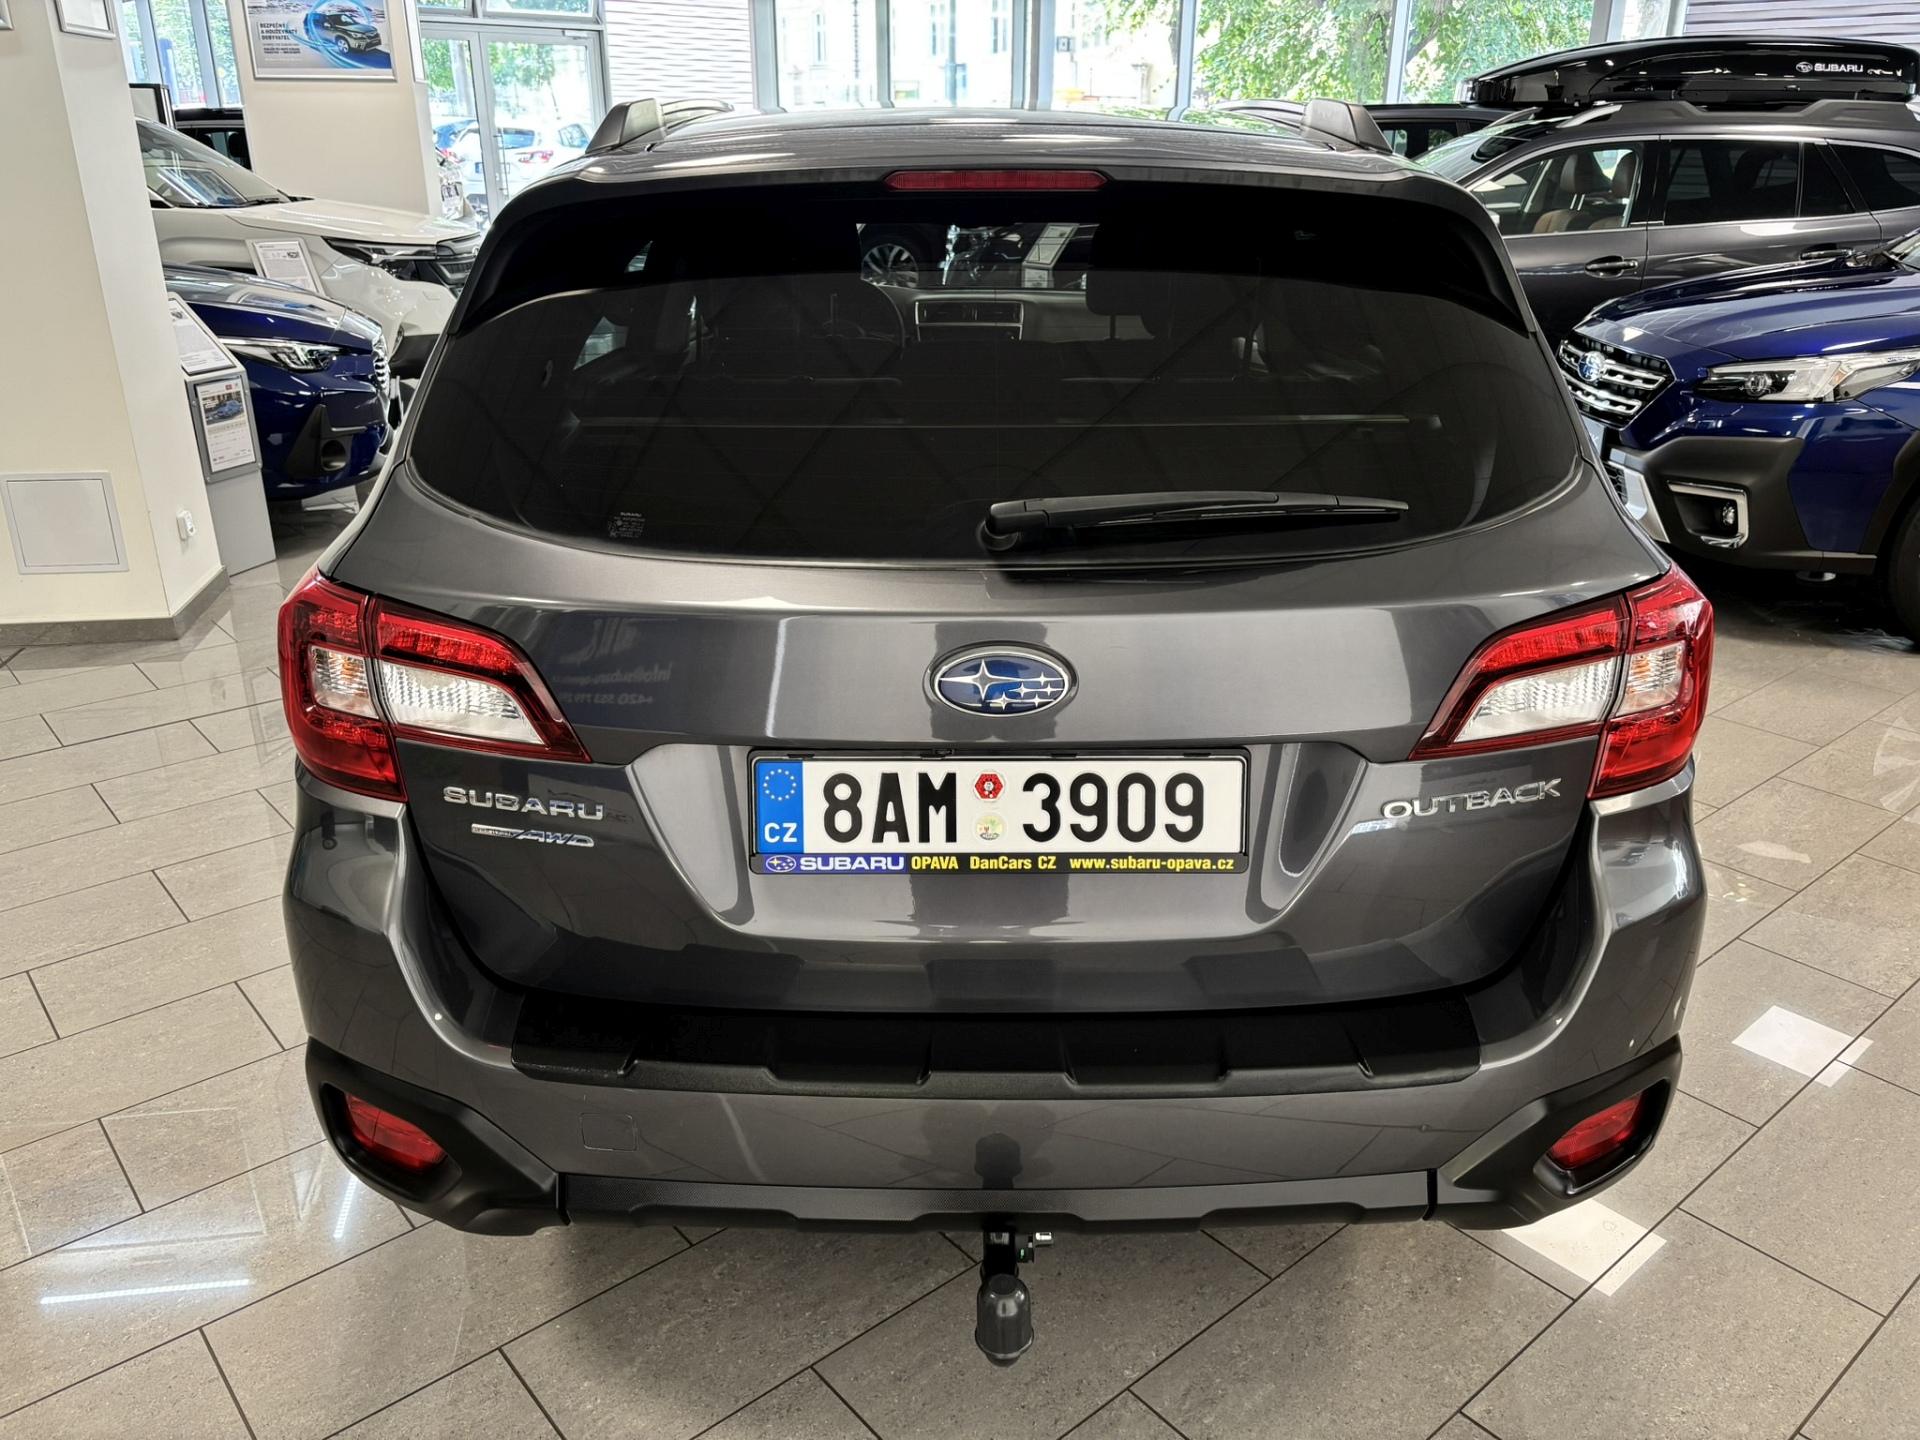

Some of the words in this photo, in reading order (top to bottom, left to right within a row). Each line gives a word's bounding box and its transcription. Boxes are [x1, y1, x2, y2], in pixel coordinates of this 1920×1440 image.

[1814, 63, 1863, 72] SUBARU
[443, 786, 604, 821] SUBARU
[822, 772, 957, 843] 8AM
[1022, 772, 1205, 843] 3909
[1382, 778, 1562, 819] OUTBACK
[515, 829, 595, 848] AWD
[764, 823, 798, 843] CZ
[799, 856, 905, 871] SUBARU
[911, 856, 959, 870] OPAVA
[969, 855, 1032, 870] DanCars
[1038, 856, 1057, 870] CZ
[1069, 855, 1235, 873] www.subaru-opava.cz
